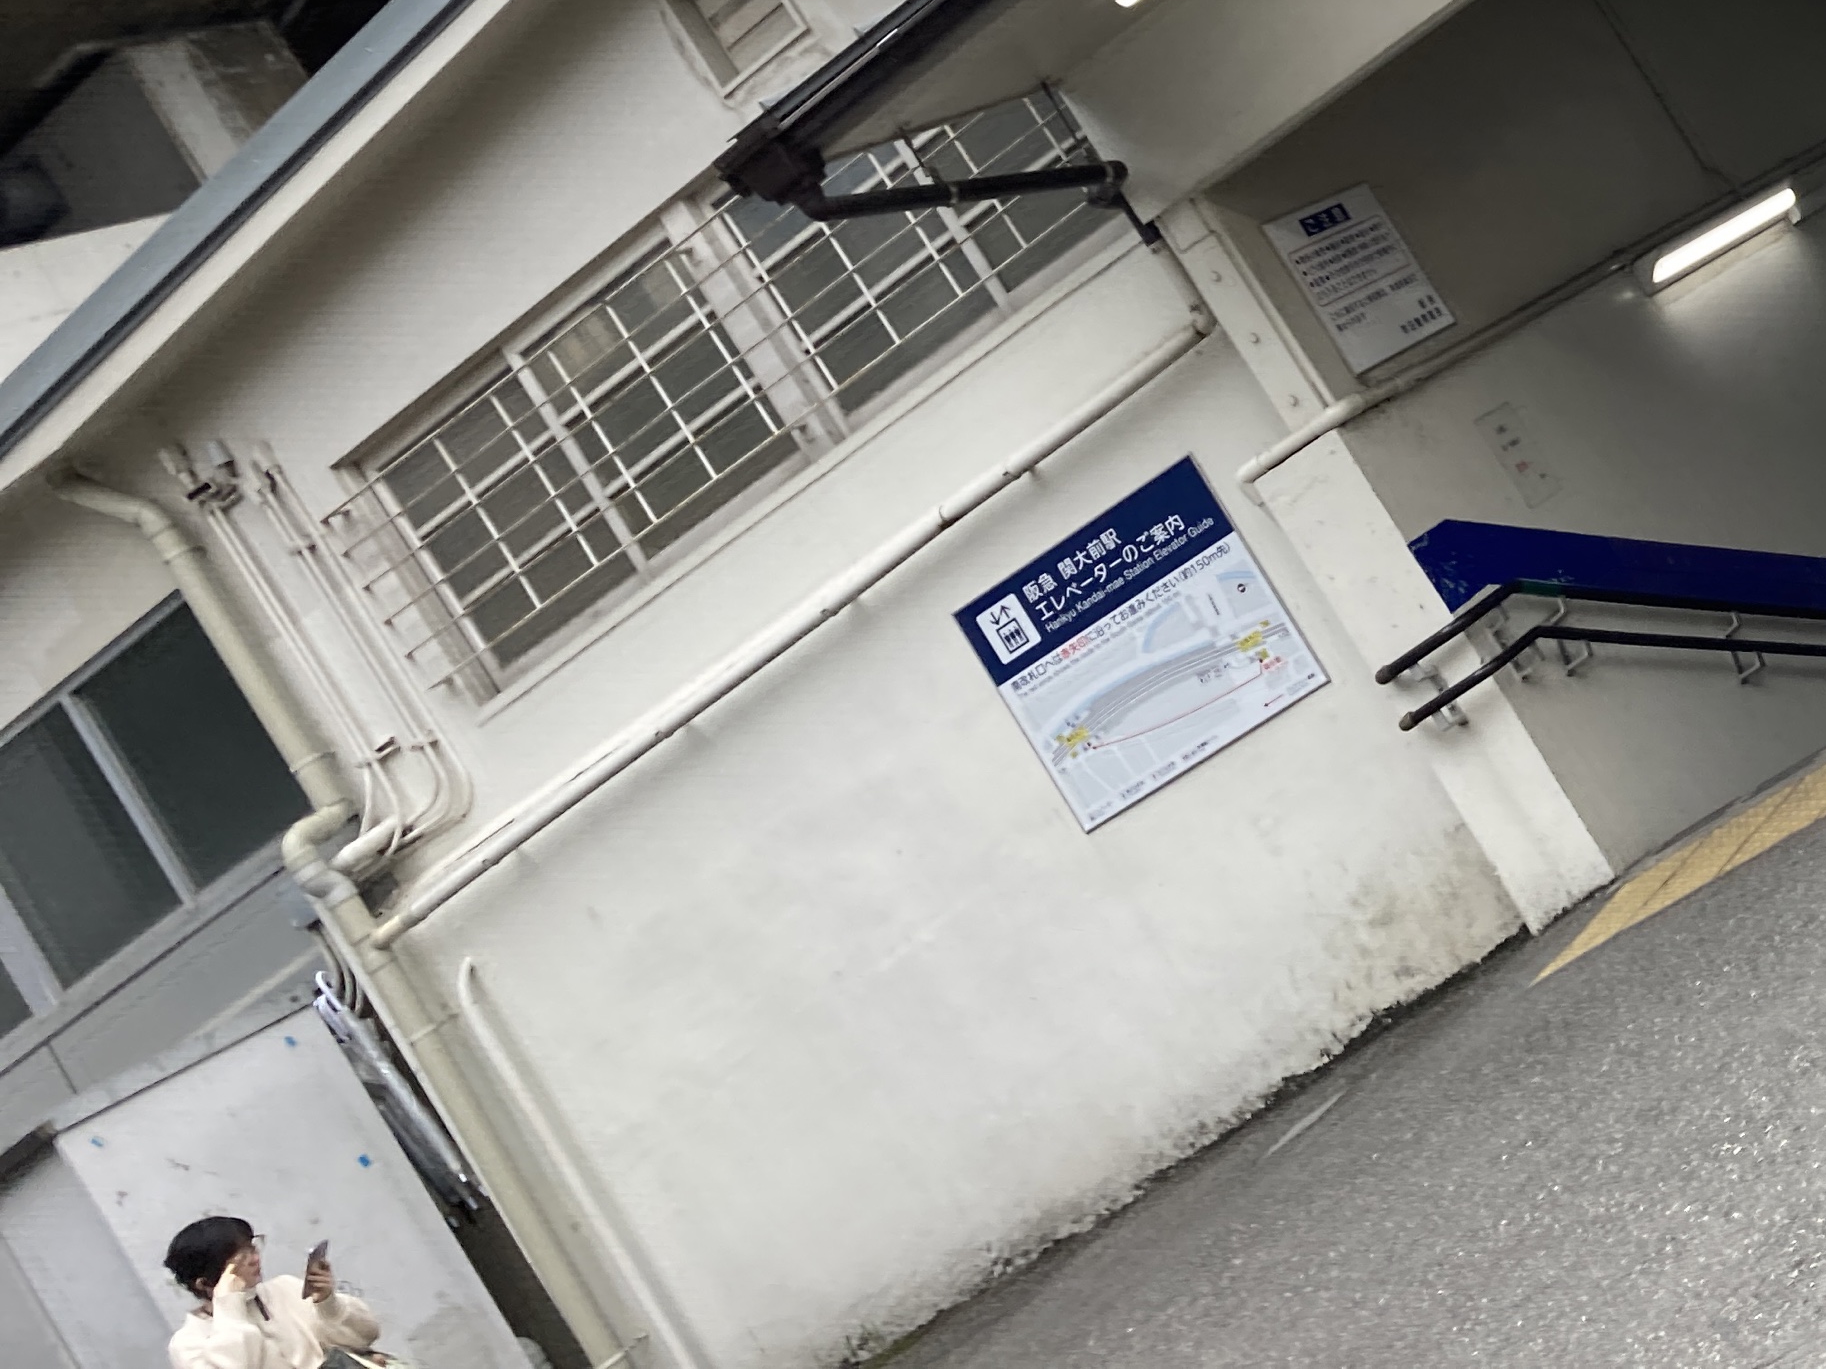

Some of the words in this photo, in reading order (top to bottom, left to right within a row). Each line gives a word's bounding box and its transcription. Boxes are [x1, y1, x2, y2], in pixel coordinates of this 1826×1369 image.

[1022, 573, 1058, 603] 阪急
[1057, 527, 1122, 579] 関大前駅
[1035, 514, 1186, 621] エレベーターのご案内
[1044, 605, 1077, 633] Hankyu
[1075, 574, 1125, 611] Kandai-mae
[1123, 554, 1154, 580] Station
[1152, 532, 1188, 560] Elevator
[1187, 515, 1215, 538] Guide
